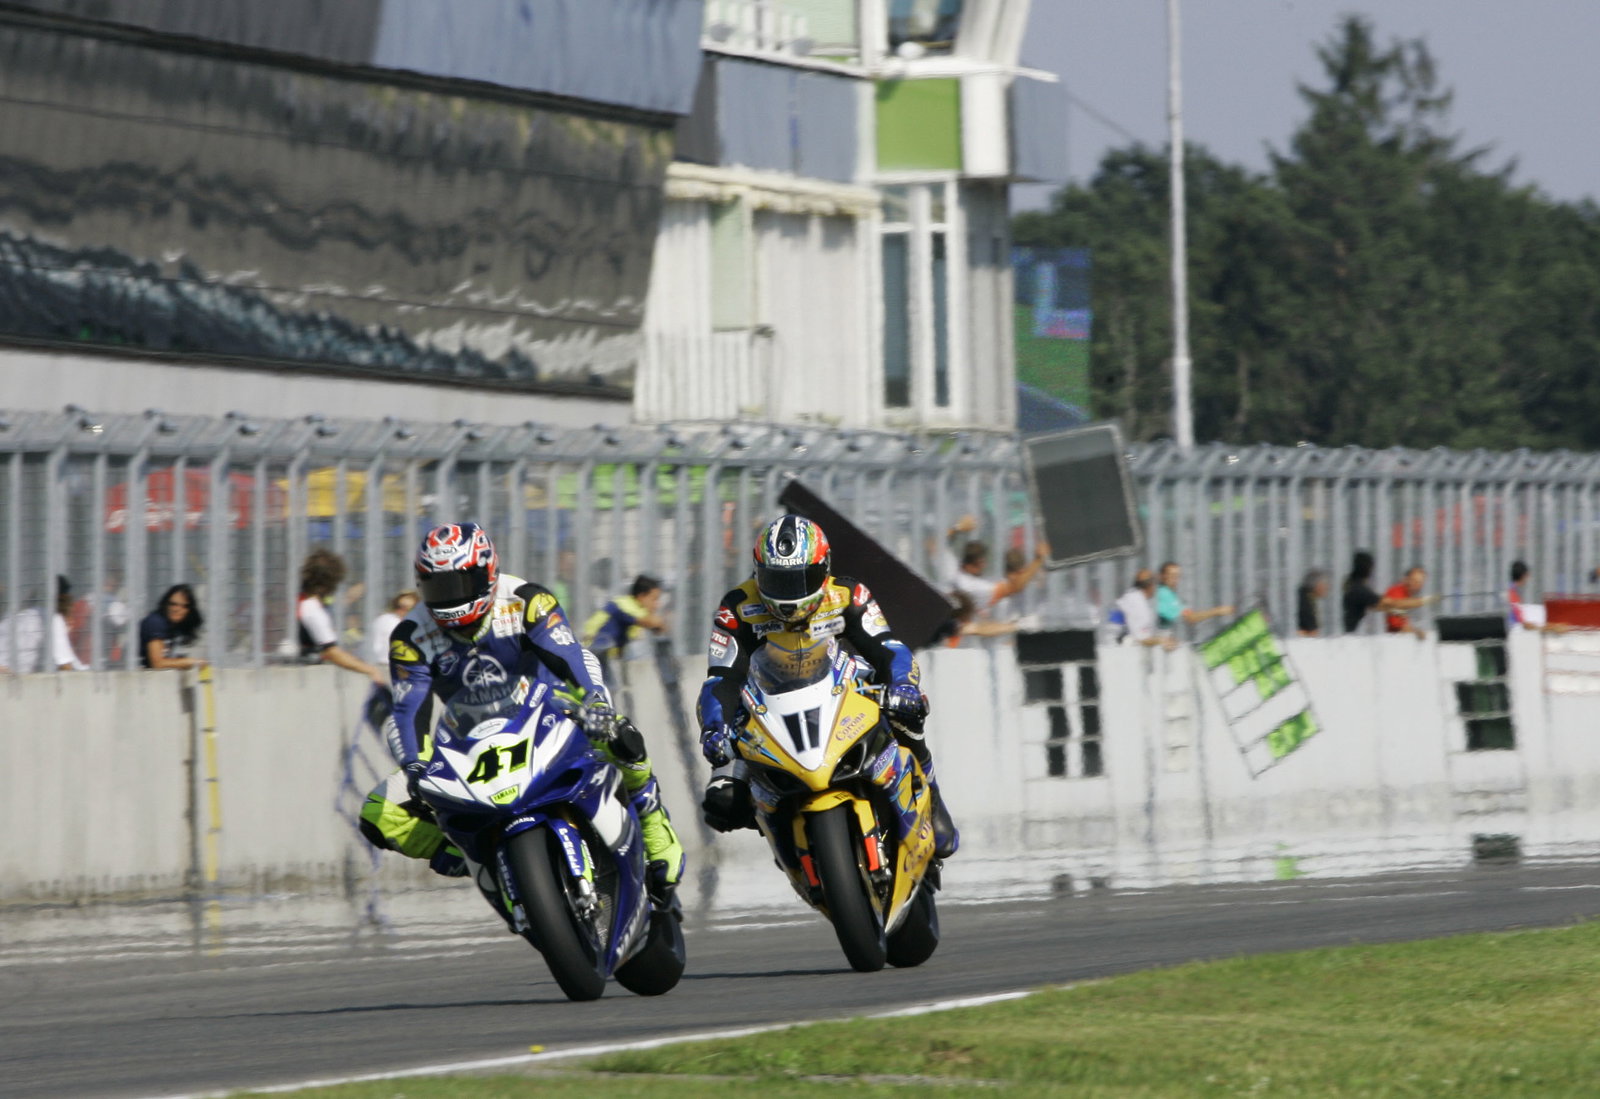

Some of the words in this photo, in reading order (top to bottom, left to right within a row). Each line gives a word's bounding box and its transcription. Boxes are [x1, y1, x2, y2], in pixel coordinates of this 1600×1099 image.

[769, 557, 804, 567] SHARK
[835, 711, 866, 741] Corona
[466, 738, 530, 785] 41
[493, 787, 517, 801] YAMAHA
